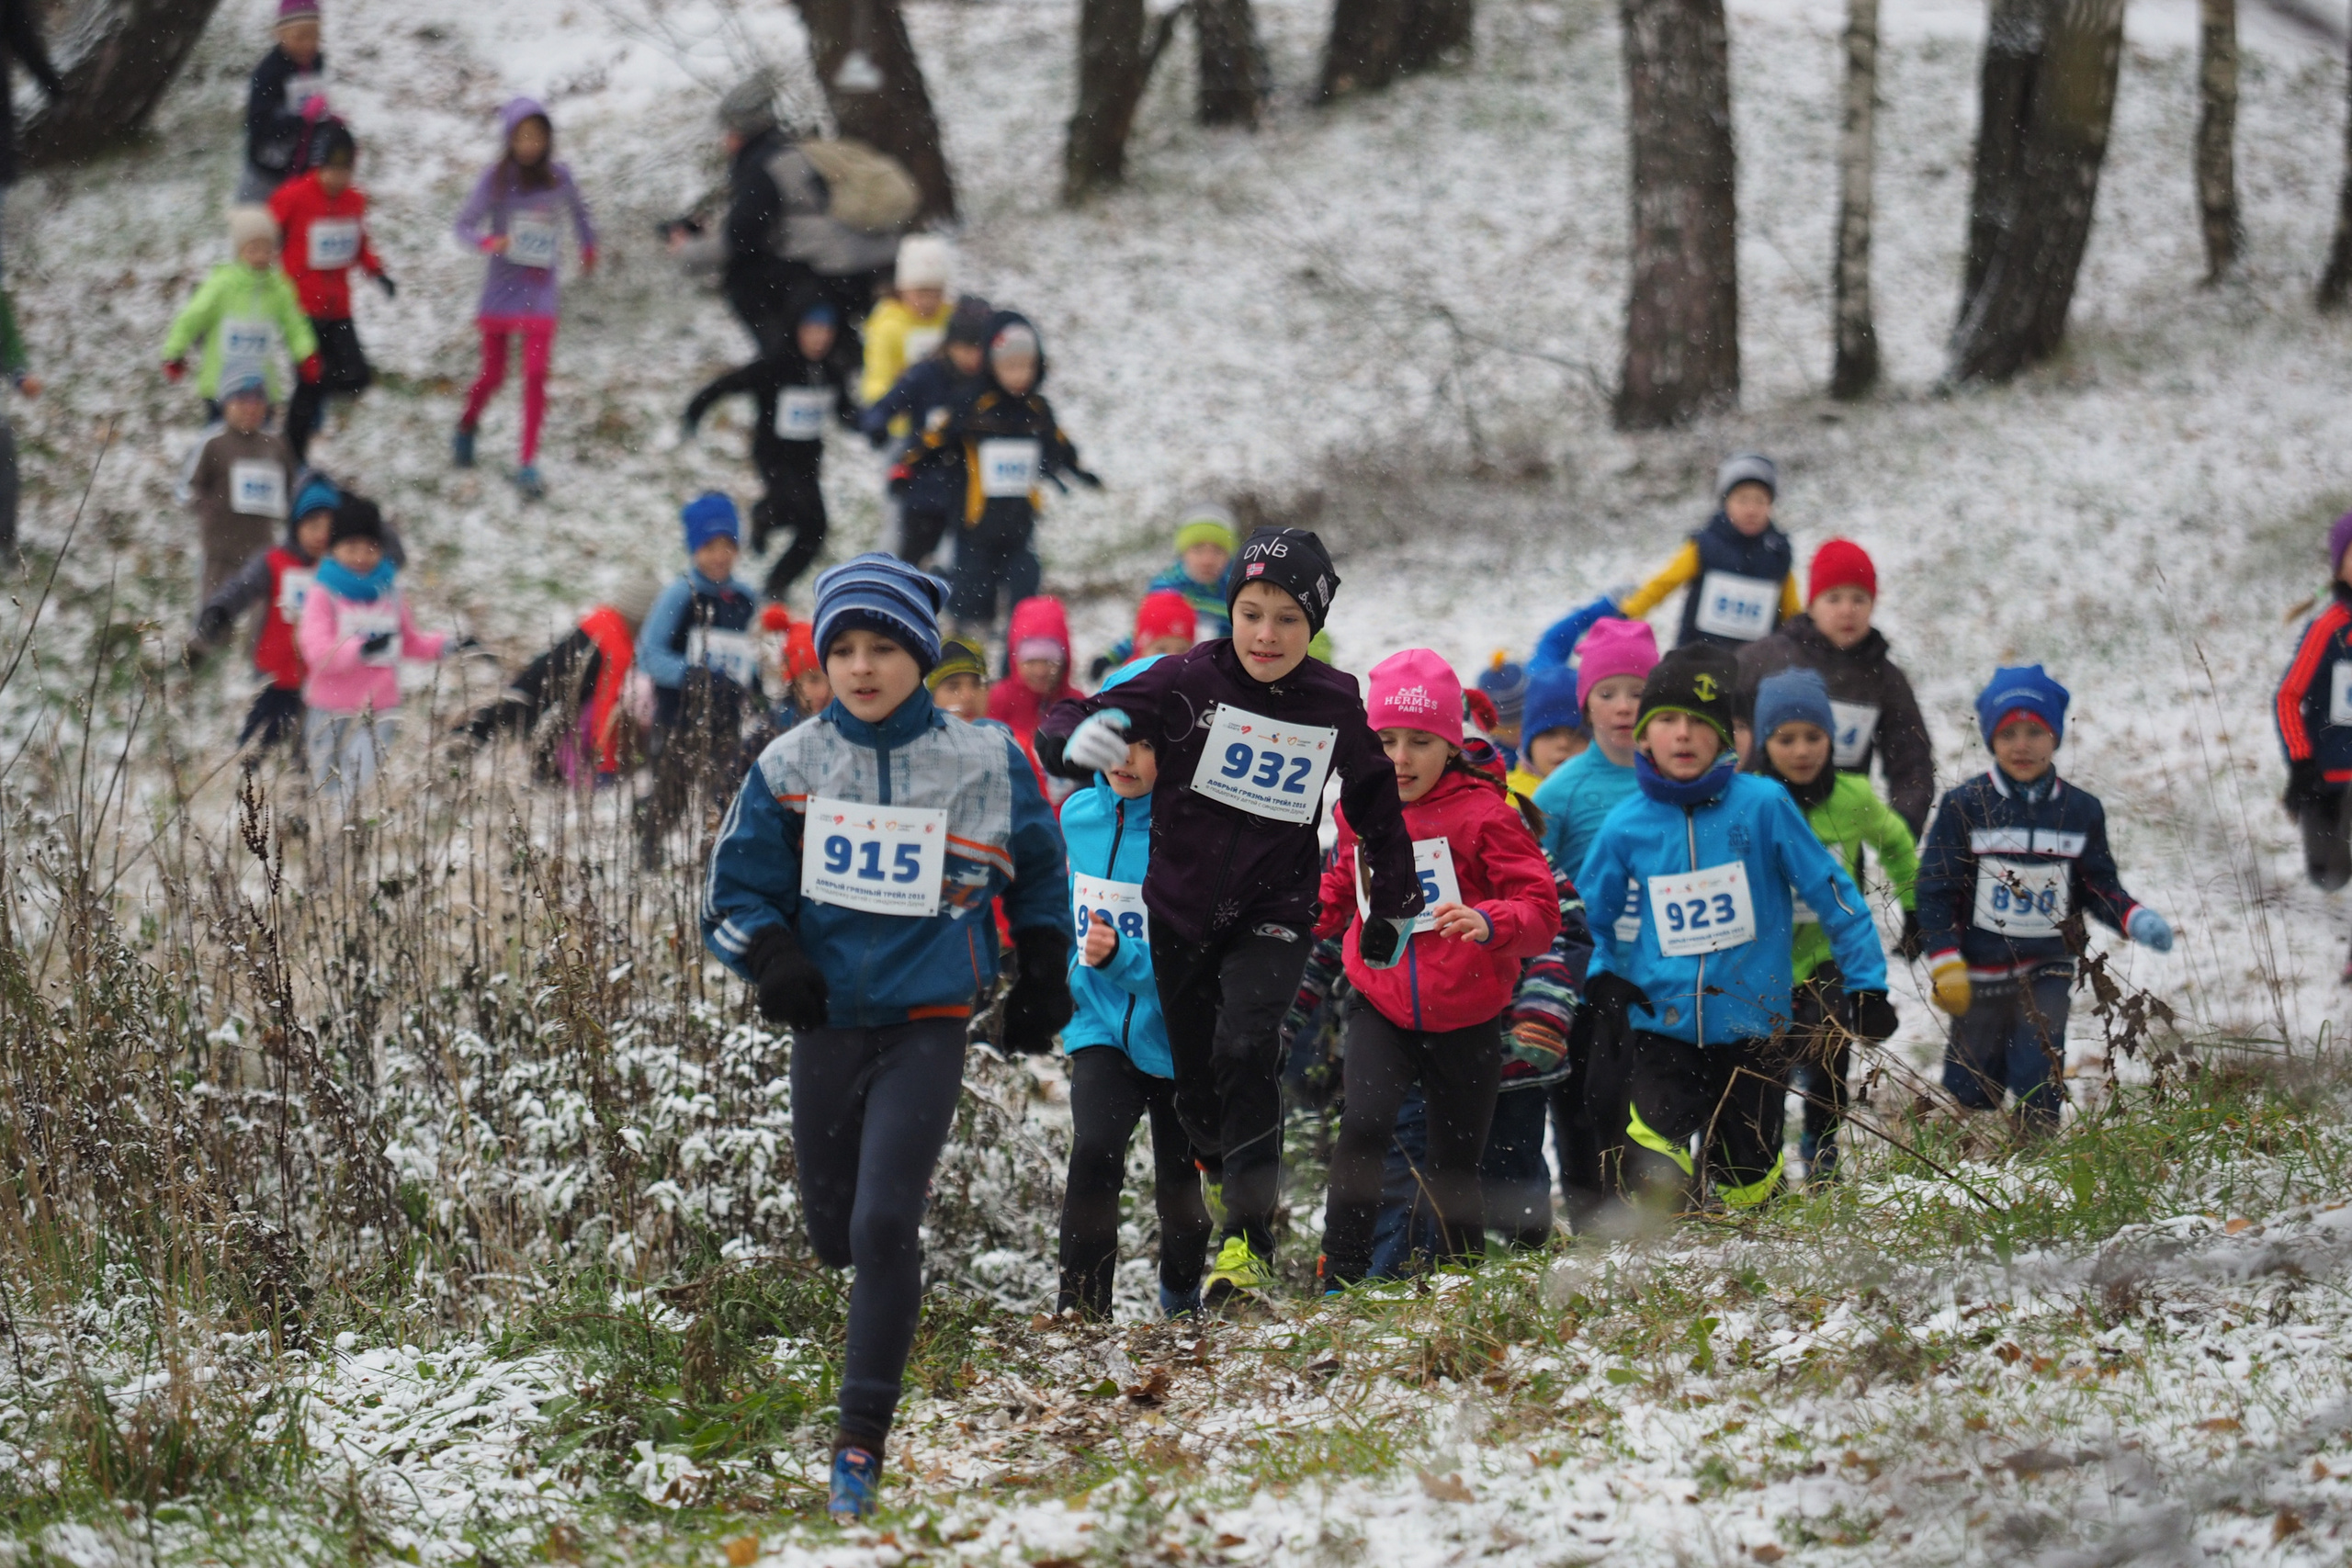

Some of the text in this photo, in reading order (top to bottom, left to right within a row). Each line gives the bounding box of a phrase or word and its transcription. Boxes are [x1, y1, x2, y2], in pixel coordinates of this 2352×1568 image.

[1243, 536, 1288, 562] DNB
[1384, 695, 1438, 710] HERMES
[1397, 705, 1424, 714] PARIS
[1220, 742, 1312, 795] 932
[1206, 779, 1238, 794] ДОБРЫЙ
[1238, 789, 1272, 803] ГРЯЗНЫЙ
[1272, 797, 1292, 807] ТРЕЙЛ
[823, 834, 922, 885] 915
[815, 878, 926, 900] ДОБРЫЙ ГРЯЗНЫЙ ТРЕЙЛ 2016
[1992, 885, 2055, 916] 890
[1666, 893, 1736, 932] 923
